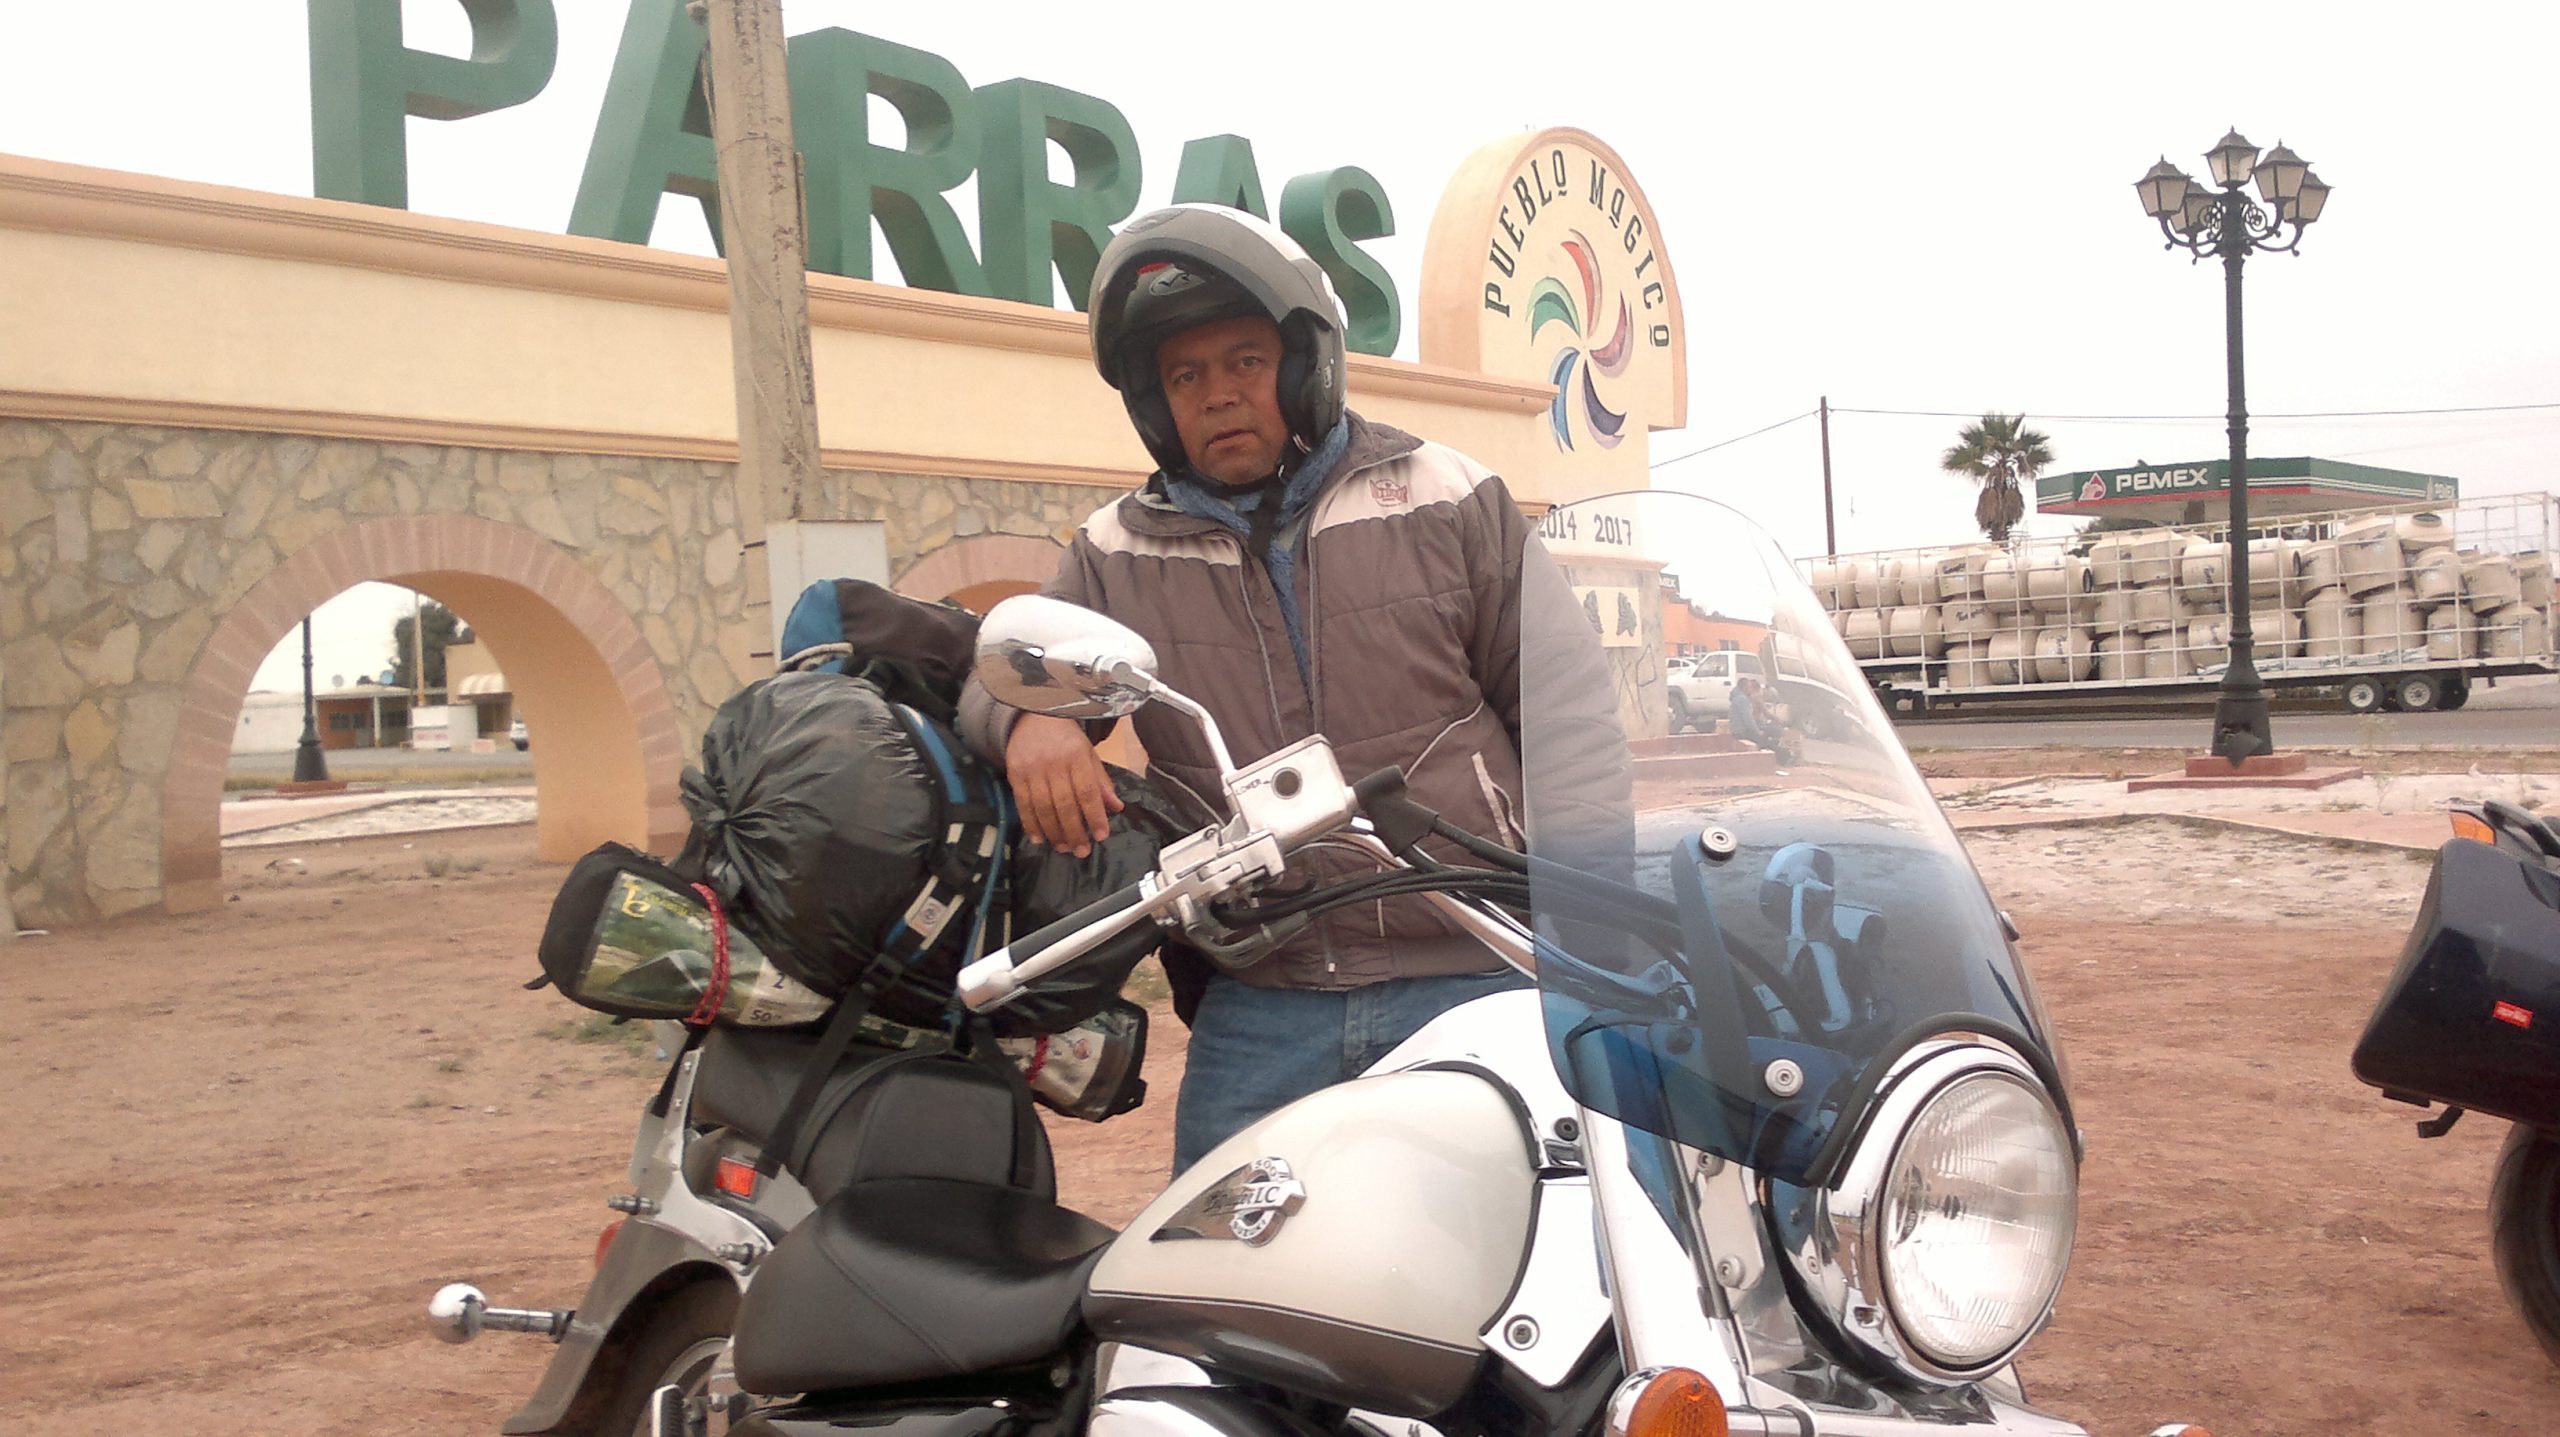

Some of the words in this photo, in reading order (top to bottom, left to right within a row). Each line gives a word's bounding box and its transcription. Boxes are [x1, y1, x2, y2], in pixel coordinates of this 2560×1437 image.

[1484, 149, 1567, 318] PUEBLO
[2116, 468, 2208, 492] PEMEX
[1538, 509, 1577, 541] 2014
[1593, 513, 1632, 546] 2017
